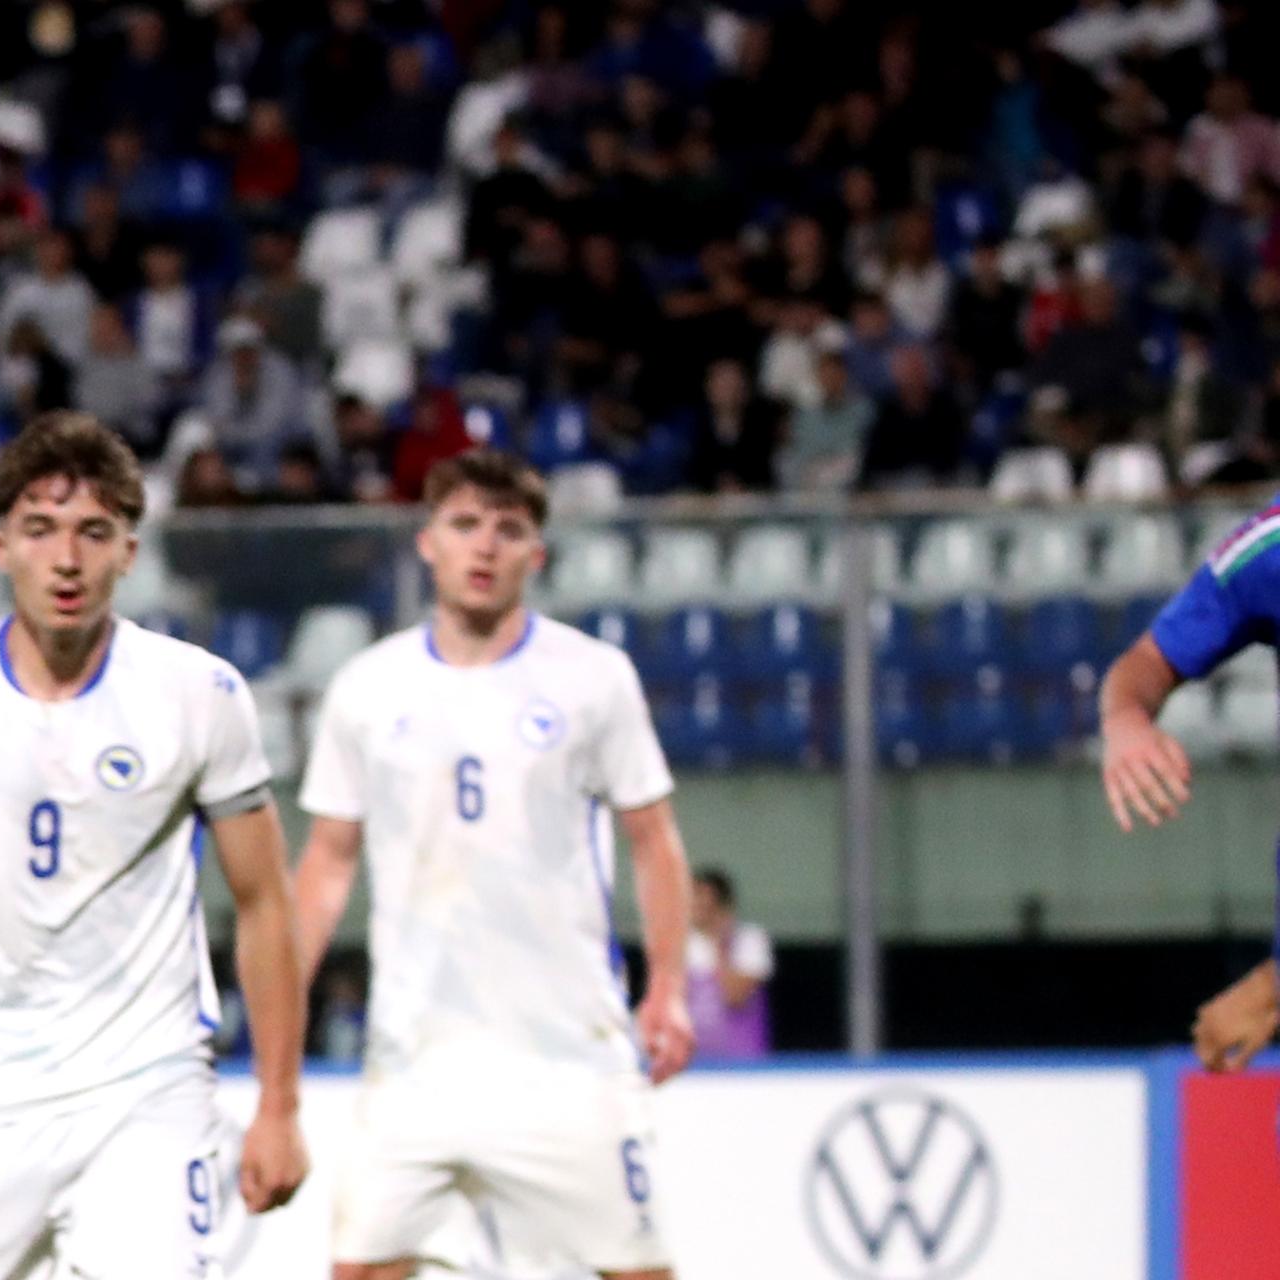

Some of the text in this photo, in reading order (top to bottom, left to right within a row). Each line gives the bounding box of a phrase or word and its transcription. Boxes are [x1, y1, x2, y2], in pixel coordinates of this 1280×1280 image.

[455, 754, 485, 822] 6
[28, 798, 62, 880] 9
[186, 1157, 211, 1236] 9
[620, 1136, 651, 1203] 6
